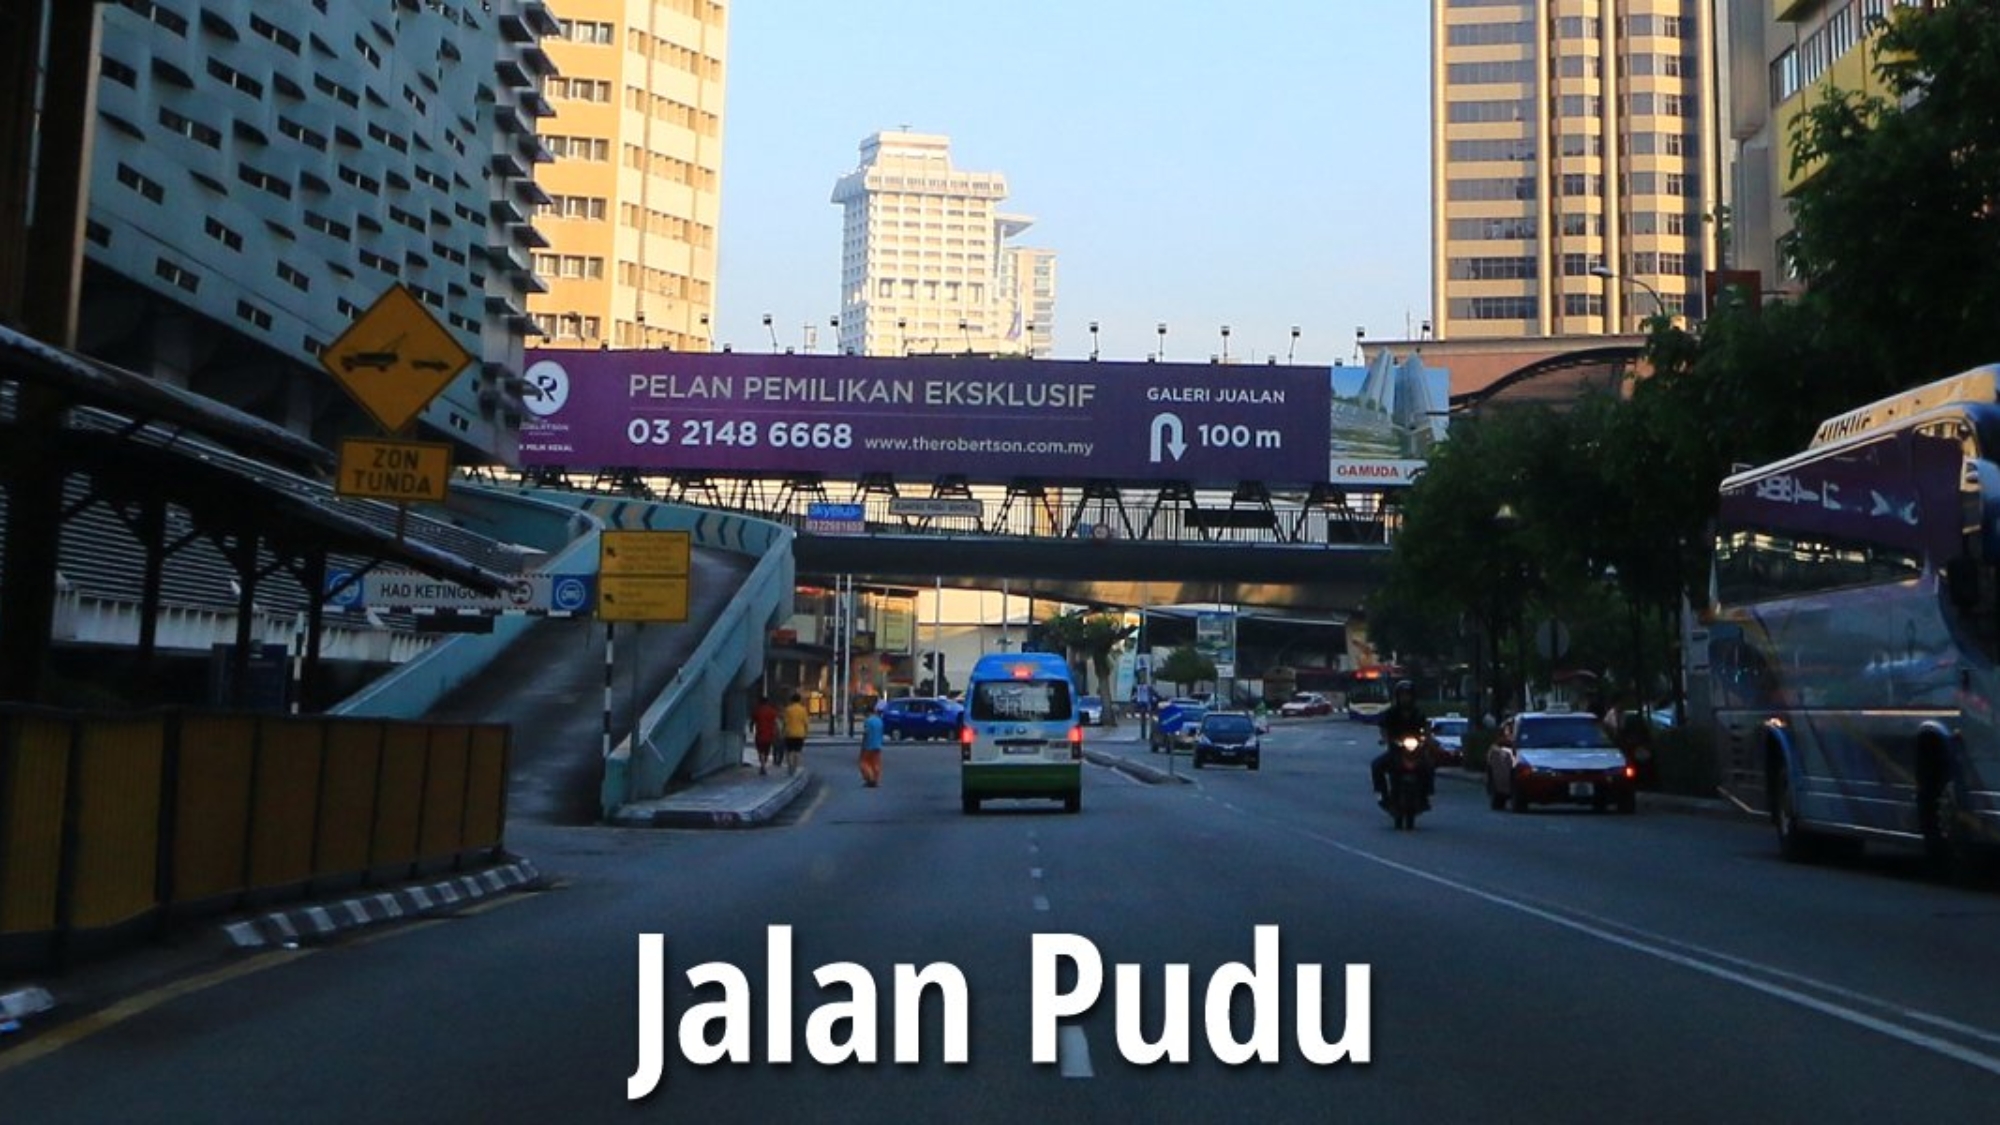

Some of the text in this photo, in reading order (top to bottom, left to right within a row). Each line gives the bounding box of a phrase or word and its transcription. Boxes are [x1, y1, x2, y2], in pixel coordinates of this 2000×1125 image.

[629, 374, 1096, 407] PELAN PEMILIKAN EKSKLUSIF
[1147, 387, 1285, 403] GALERI JUALAN
[627, 418, 852, 449] 03 2148 6668
[865, 436, 1093, 455] www.therobertson.com.my
[1198, 424, 1281, 448] 100 m
[372, 447, 419, 471] ZON
[1337, 465, 1399, 477] GAMUDA
[353, 468, 432, 496] TUNDA
[381, 584, 411, 598] HAD
